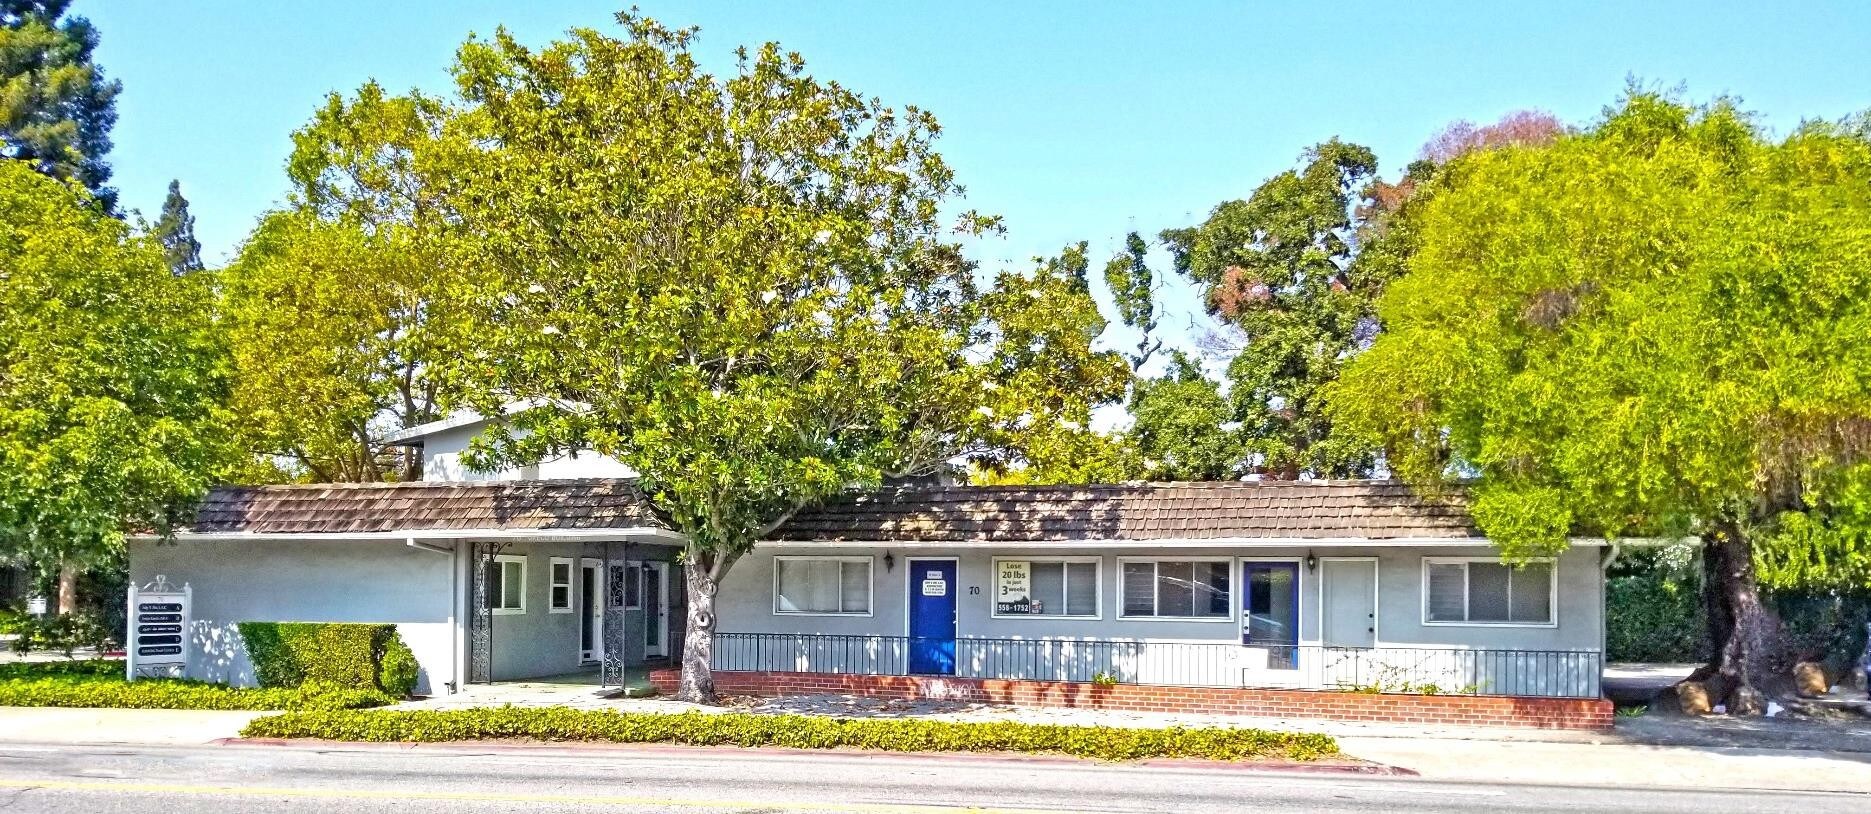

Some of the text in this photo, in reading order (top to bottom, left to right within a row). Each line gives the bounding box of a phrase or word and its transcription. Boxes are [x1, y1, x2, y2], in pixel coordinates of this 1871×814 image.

[1006, 562, 1022, 570] Lose
[1002, 570, 1026, 579] 20 lbs
[969, 586, 980, 595] 70
[1001, 586, 1008, 596] 3
[998, 604, 1029, 612] 558-1752
